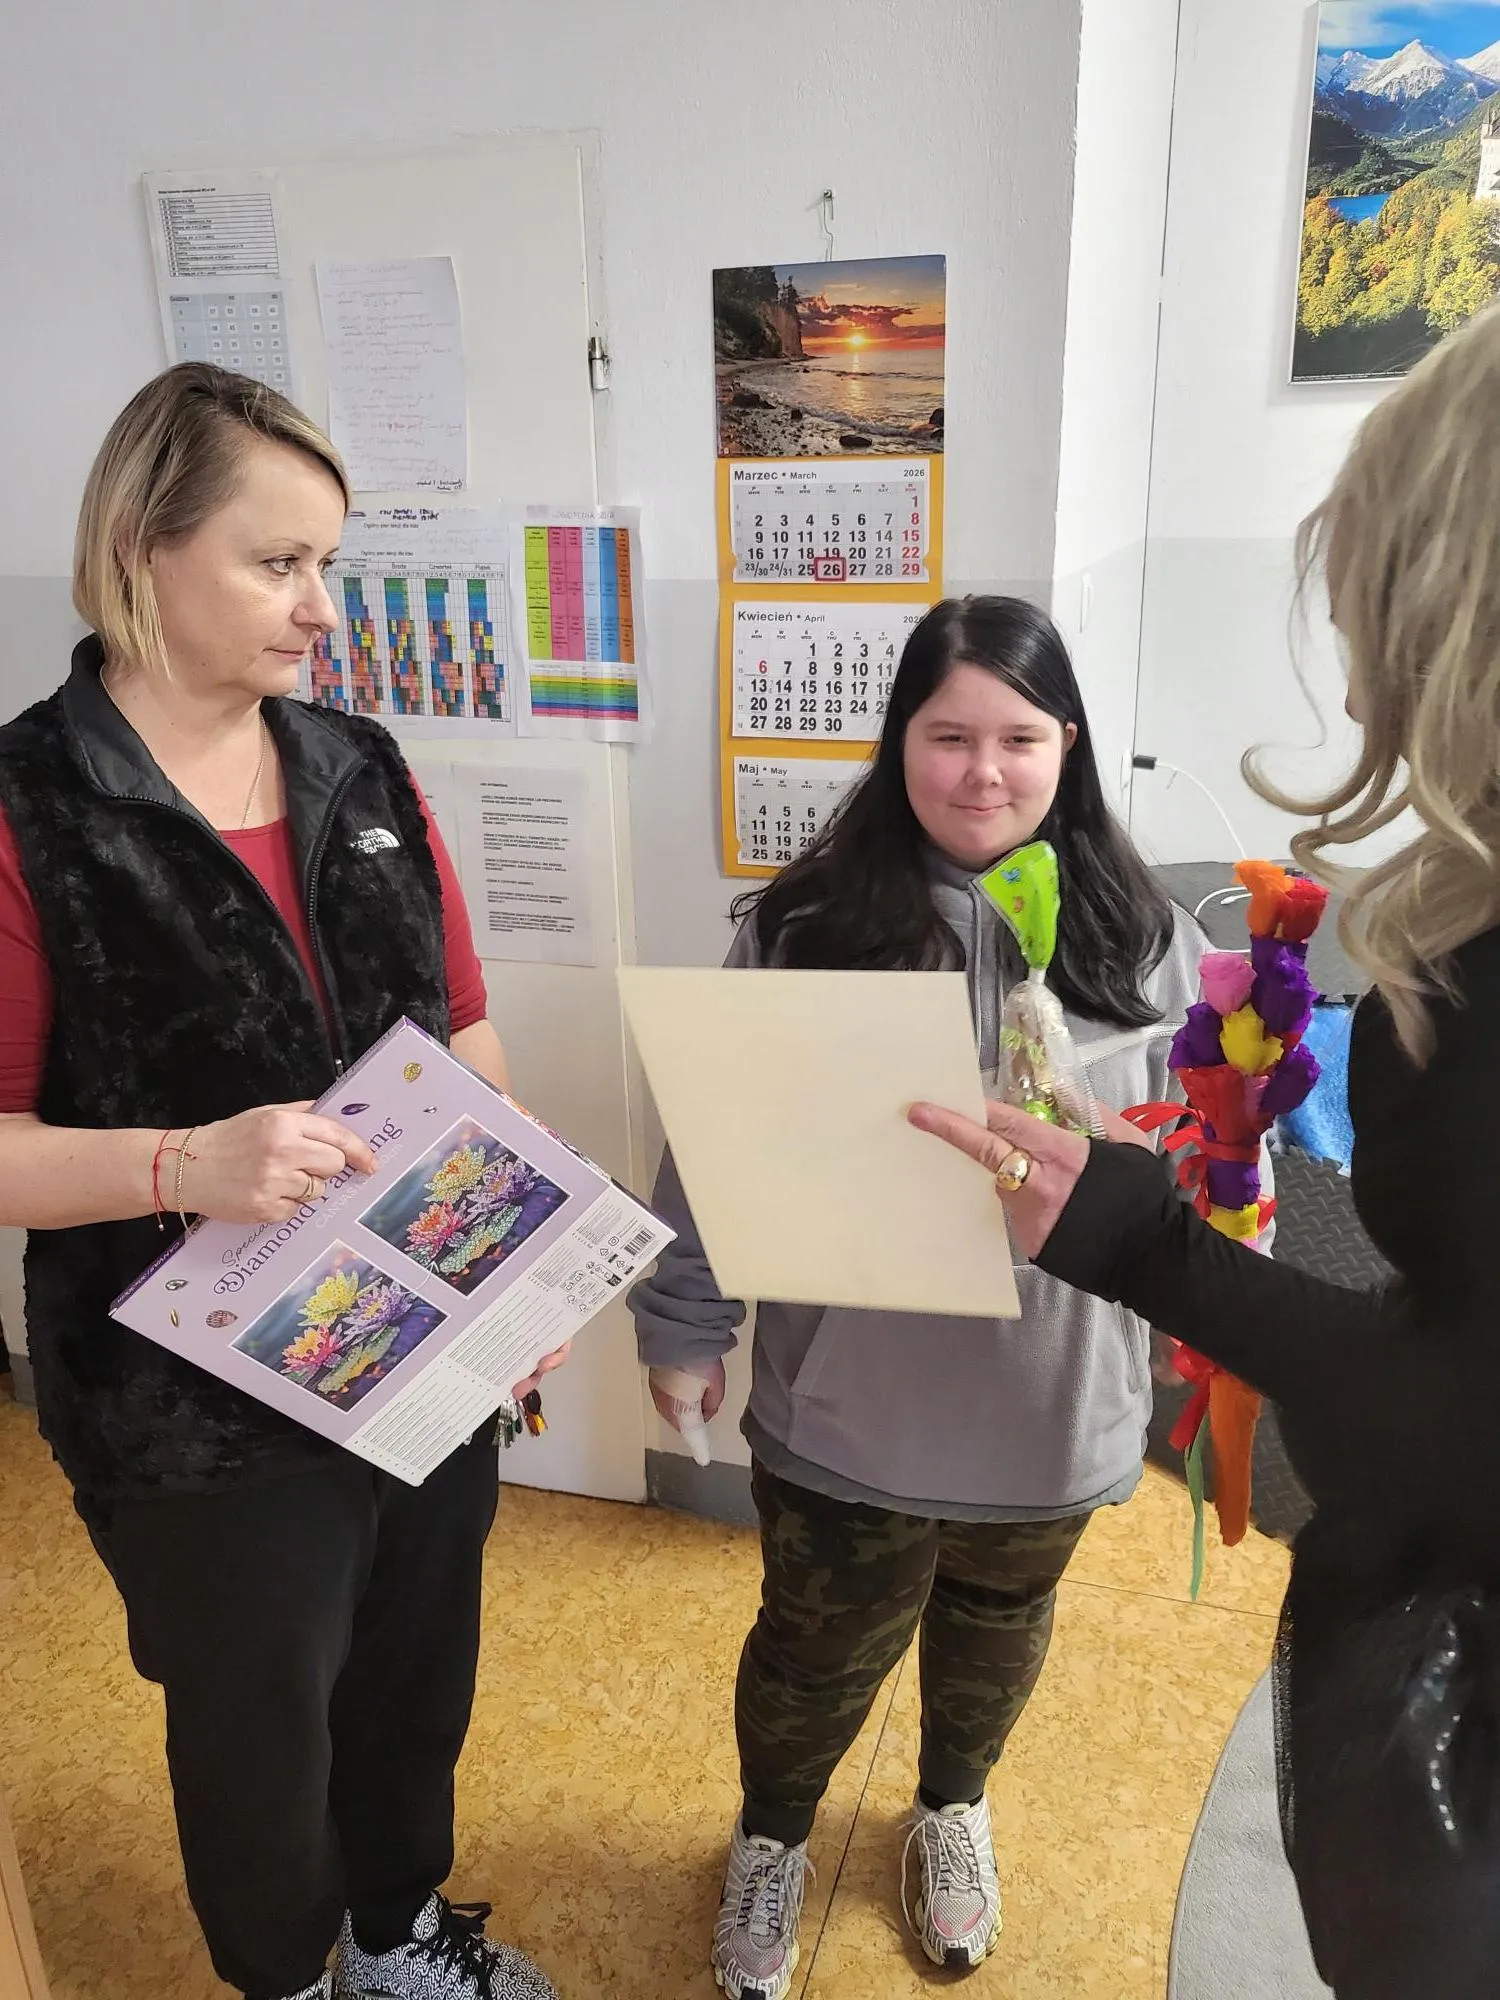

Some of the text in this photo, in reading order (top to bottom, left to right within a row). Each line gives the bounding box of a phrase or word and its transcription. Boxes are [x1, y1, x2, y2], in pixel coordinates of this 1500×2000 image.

[734, 469, 925, 480] Marzec March 2026
[912, 496, 918, 508] 1
[754, 513, 920, 527] 2 3 4 5 6 7 8
[755, 529, 920, 543] 9 10 11 12 13 14 15
[747, 546, 920, 560] 16 17 18 19 20 21 22
[745, 562, 920, 577] 23/30 24/31 25 26 27 28 29
[737, 610, 793, 622] Kwiecień
[804, 615, 825, 623] April
[809, 643, 894, 658] 1 2 3 4
[758, 660, 768, 674] 6
[783, 661, 792, 674] 7
[808, 662, 818, 676] 8
[833, 662, 843, 676] 9
[851, 663, 869, 676] 10
[876, 663, 893, 677] 11
[751, 678, 768, 693] 13
[775, 679, 792, 693] 14
[800, 680, 817, 694] 15
[825, 681, 843, 694] 16
[851, 681, 868, 695] 17
[876, 682, 893, 696] 18
[750, 697, 768, 711] 20
[775, 698, 791, 712] 21
[799, 699, 817, 712] 22
[825, 699, 842, 713] 23
[850, 700, 868, 714] 24
[750, 715, 842, 732] 27 28 29 30
[739, 763, 788, 777] Maj May
[759, 805, 816, 818] 4 5 6
[752, 820, 816, 833] 11 12 13
[361, 829, 379, 839] THE
[752, 834, 815, 848] 18 19 20
[752, 849, 792, 861] 25 26
[213, 1203, 316, 1296] Diamond
[222, 1221, 274, 1268] Specia
